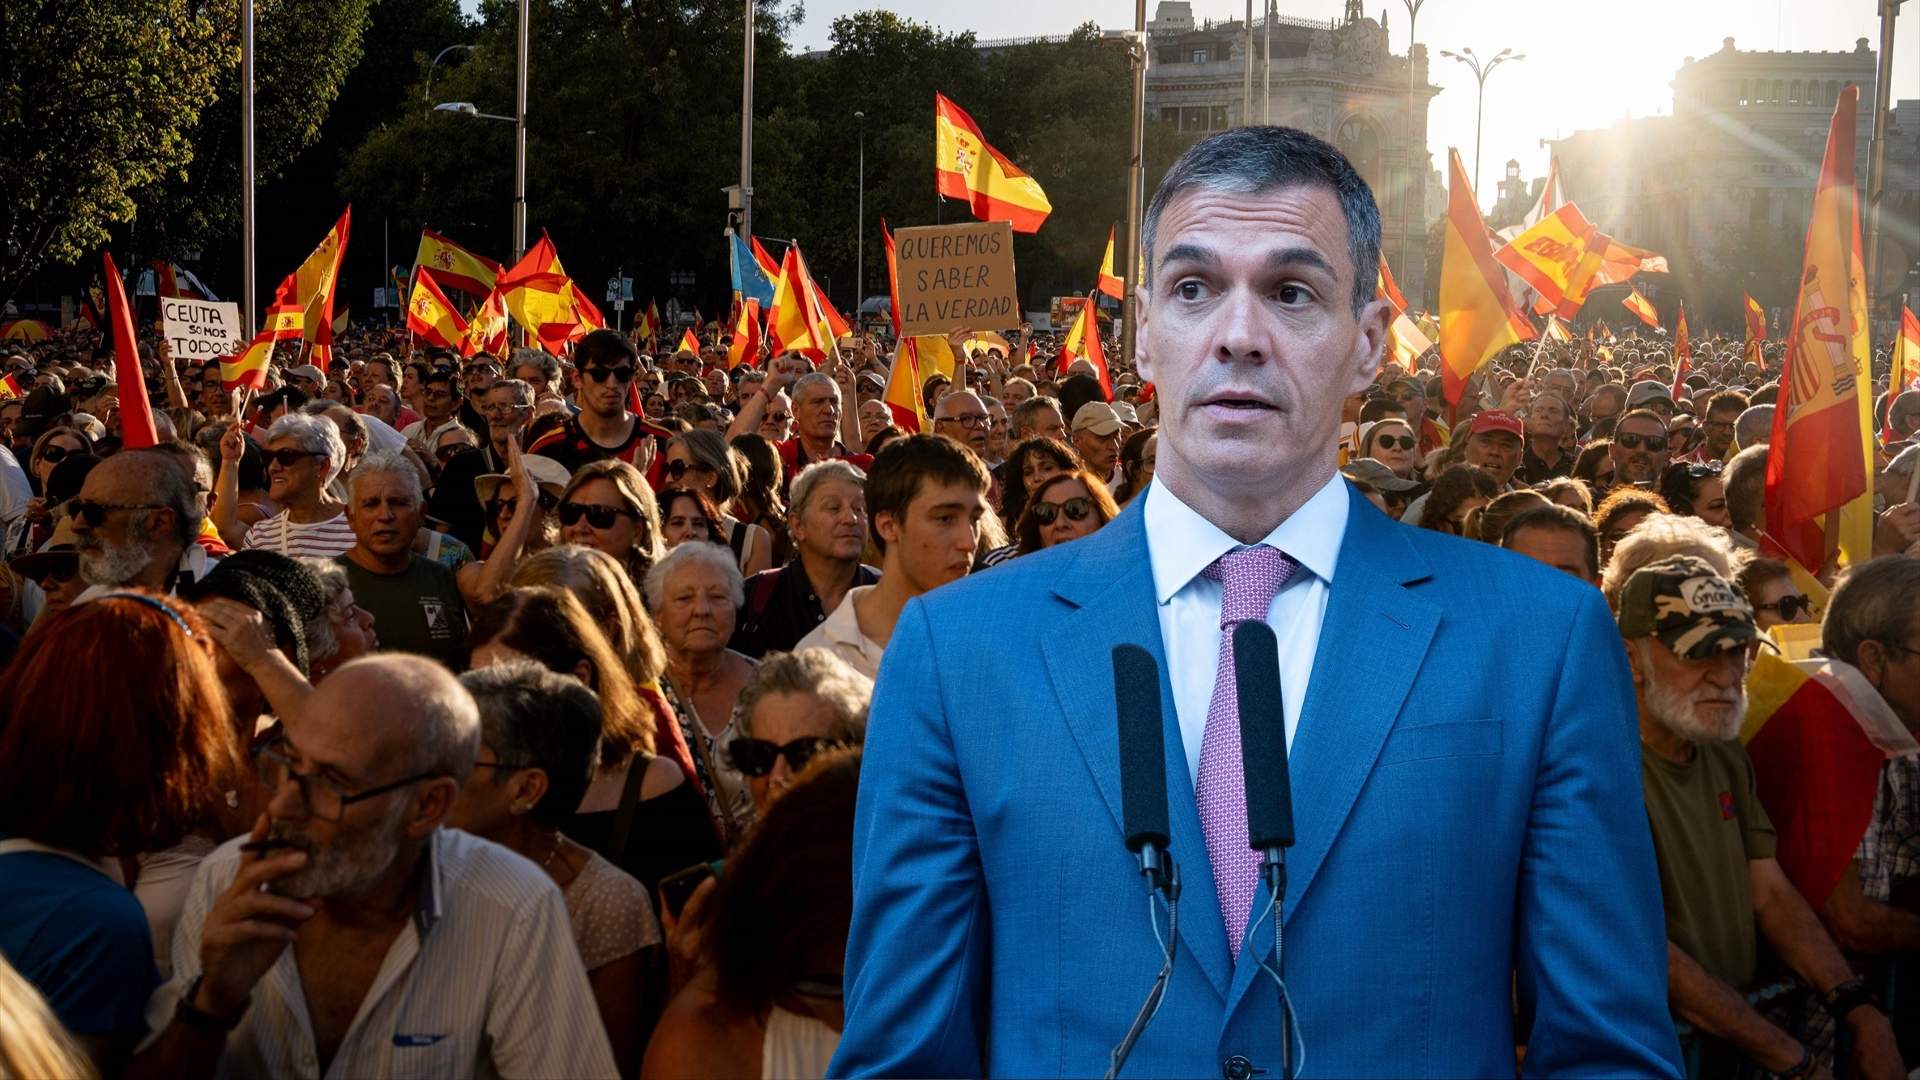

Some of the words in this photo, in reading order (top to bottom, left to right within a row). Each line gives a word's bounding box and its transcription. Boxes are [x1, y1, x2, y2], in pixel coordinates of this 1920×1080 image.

[901, 231, 1001, 260] QUEREMOS
[917, 264, 990, 292] SABER
[904, 302, 929, 322] LA
[935, 295, 1011, 320] VERDAD
[188, 324, 227, 338] SOMOS
